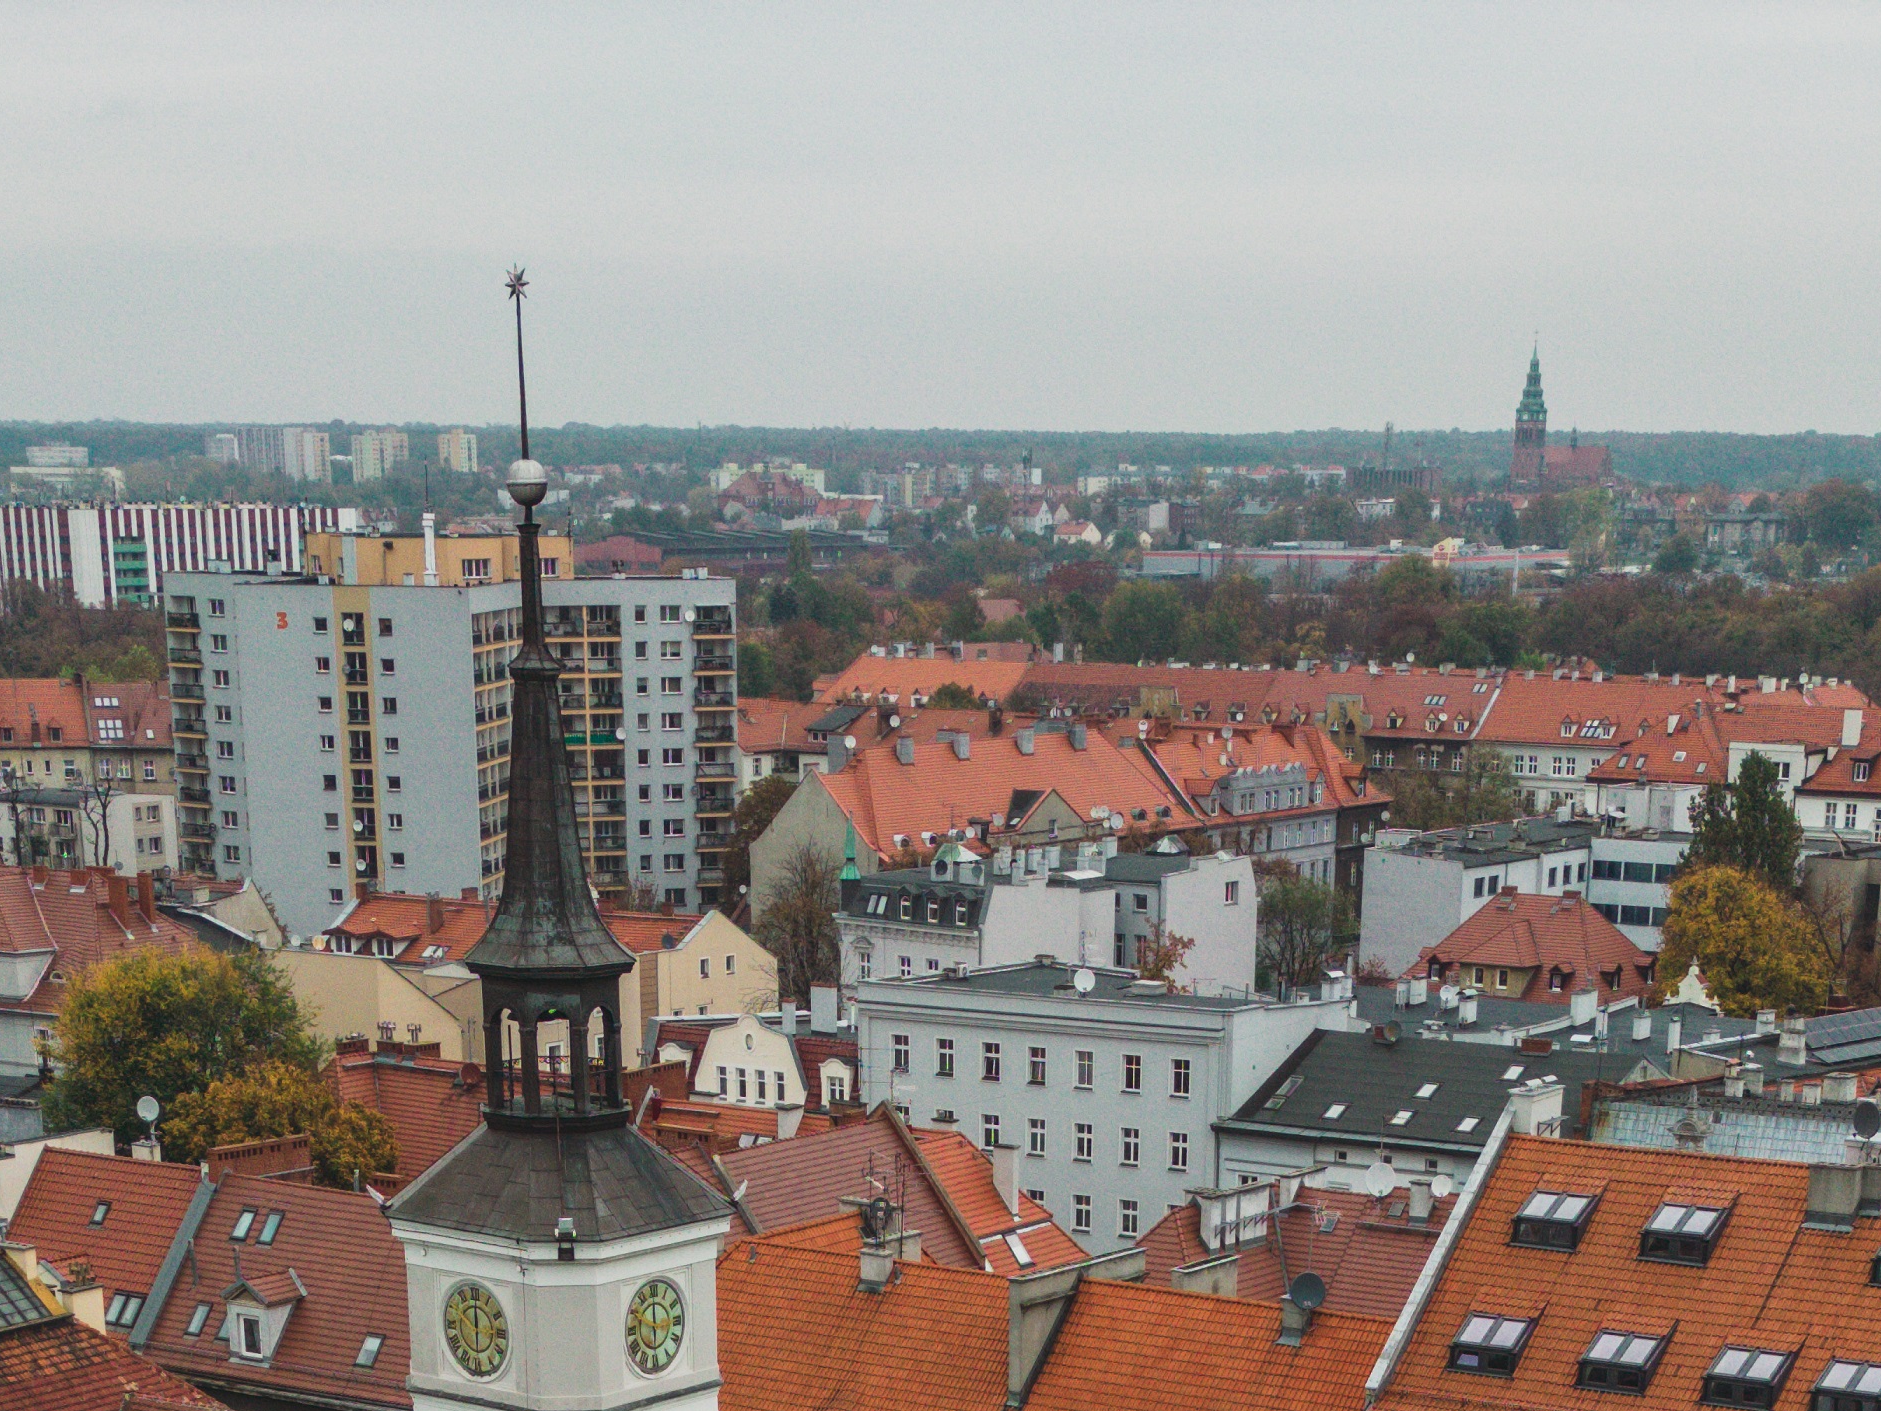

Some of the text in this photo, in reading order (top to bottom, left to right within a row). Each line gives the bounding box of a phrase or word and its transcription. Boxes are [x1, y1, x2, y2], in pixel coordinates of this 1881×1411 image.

[276, 611, 288, 629] 3
[673, 1315, 682, 1326] III
[496, 1328, 506, 1340] III
